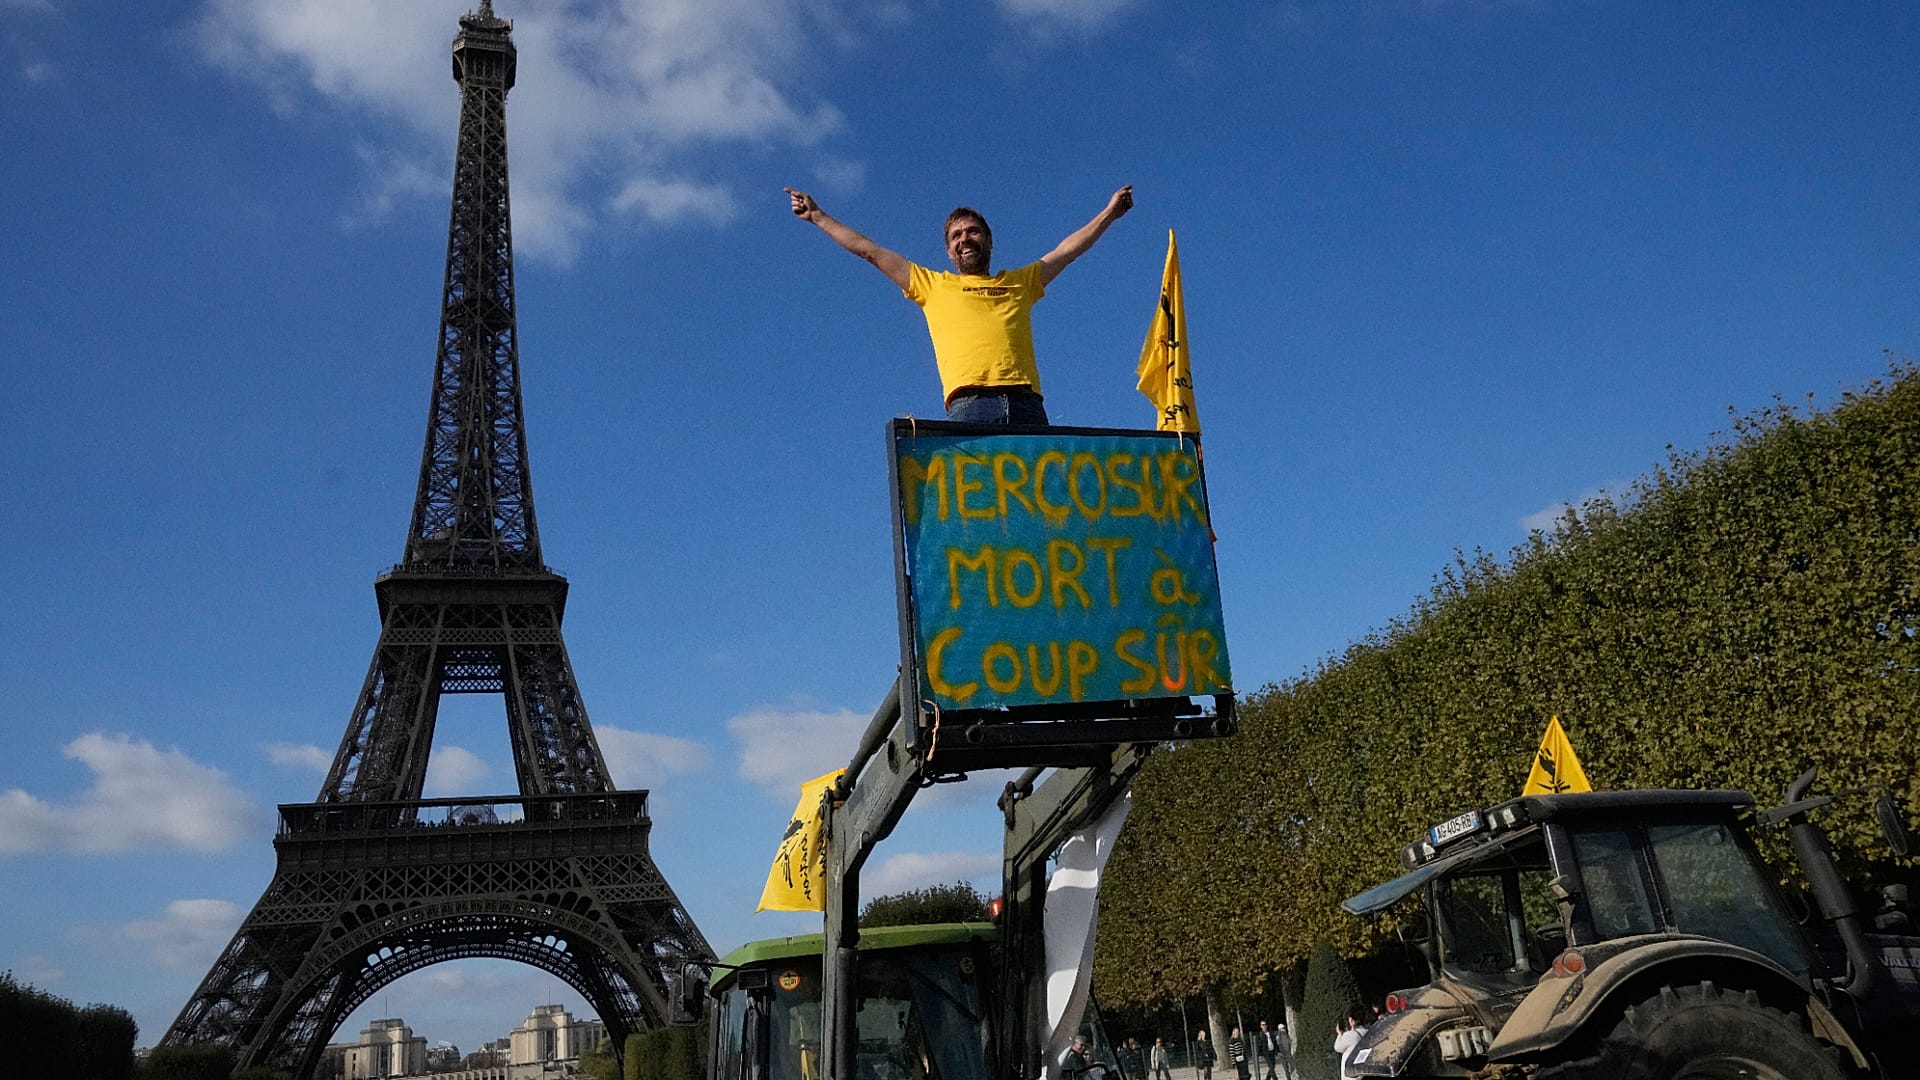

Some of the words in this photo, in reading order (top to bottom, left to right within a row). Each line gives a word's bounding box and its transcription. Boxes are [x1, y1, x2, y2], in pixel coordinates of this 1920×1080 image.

[901, 452, 1207, 525] MERCOSUR
[945, 537, 1132, 610] MORT
[1150, 547, 1200, 605] à
[925, 626, 1099, 701] COUP
[1115, 613, 1228, 695] SÛR
